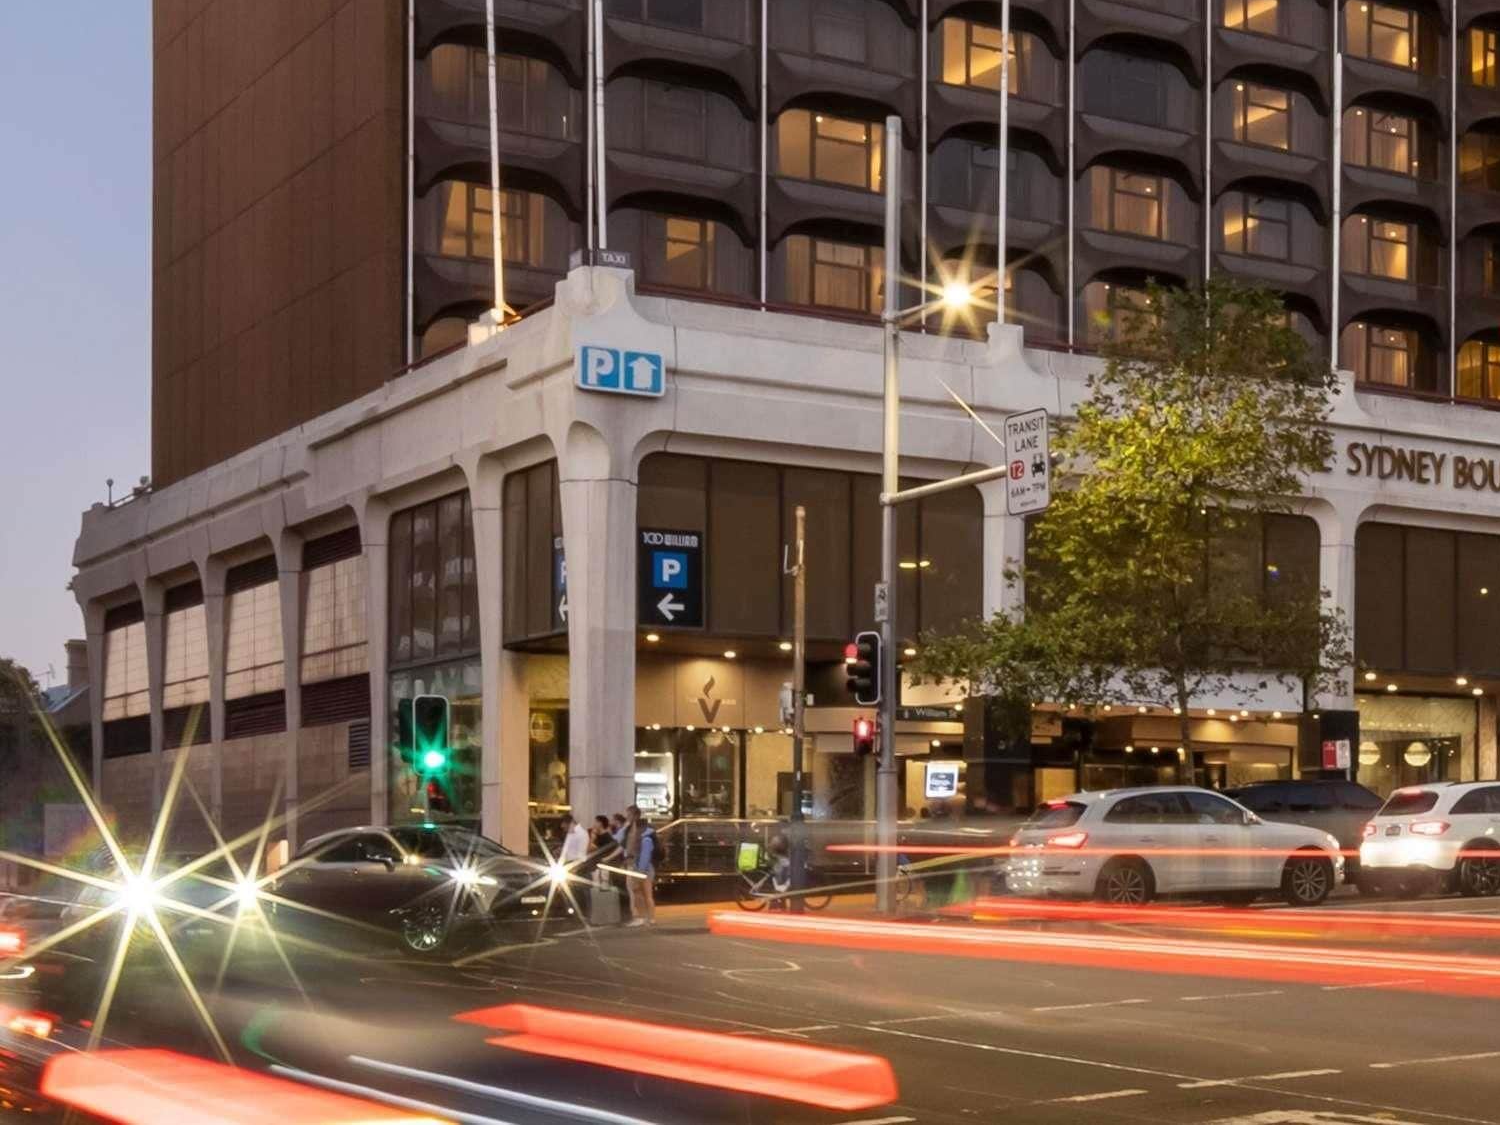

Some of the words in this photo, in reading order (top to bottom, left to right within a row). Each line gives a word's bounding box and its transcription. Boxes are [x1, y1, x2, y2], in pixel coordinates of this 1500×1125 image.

[587, 347, 614, 386] P
[1008, 416, 1045, 436] TRANSIT
[1015, 435, 1039, 453] LANE
[1347, 442, 1447, 485] SYDNEY
[661, 558, 681, 583] P
